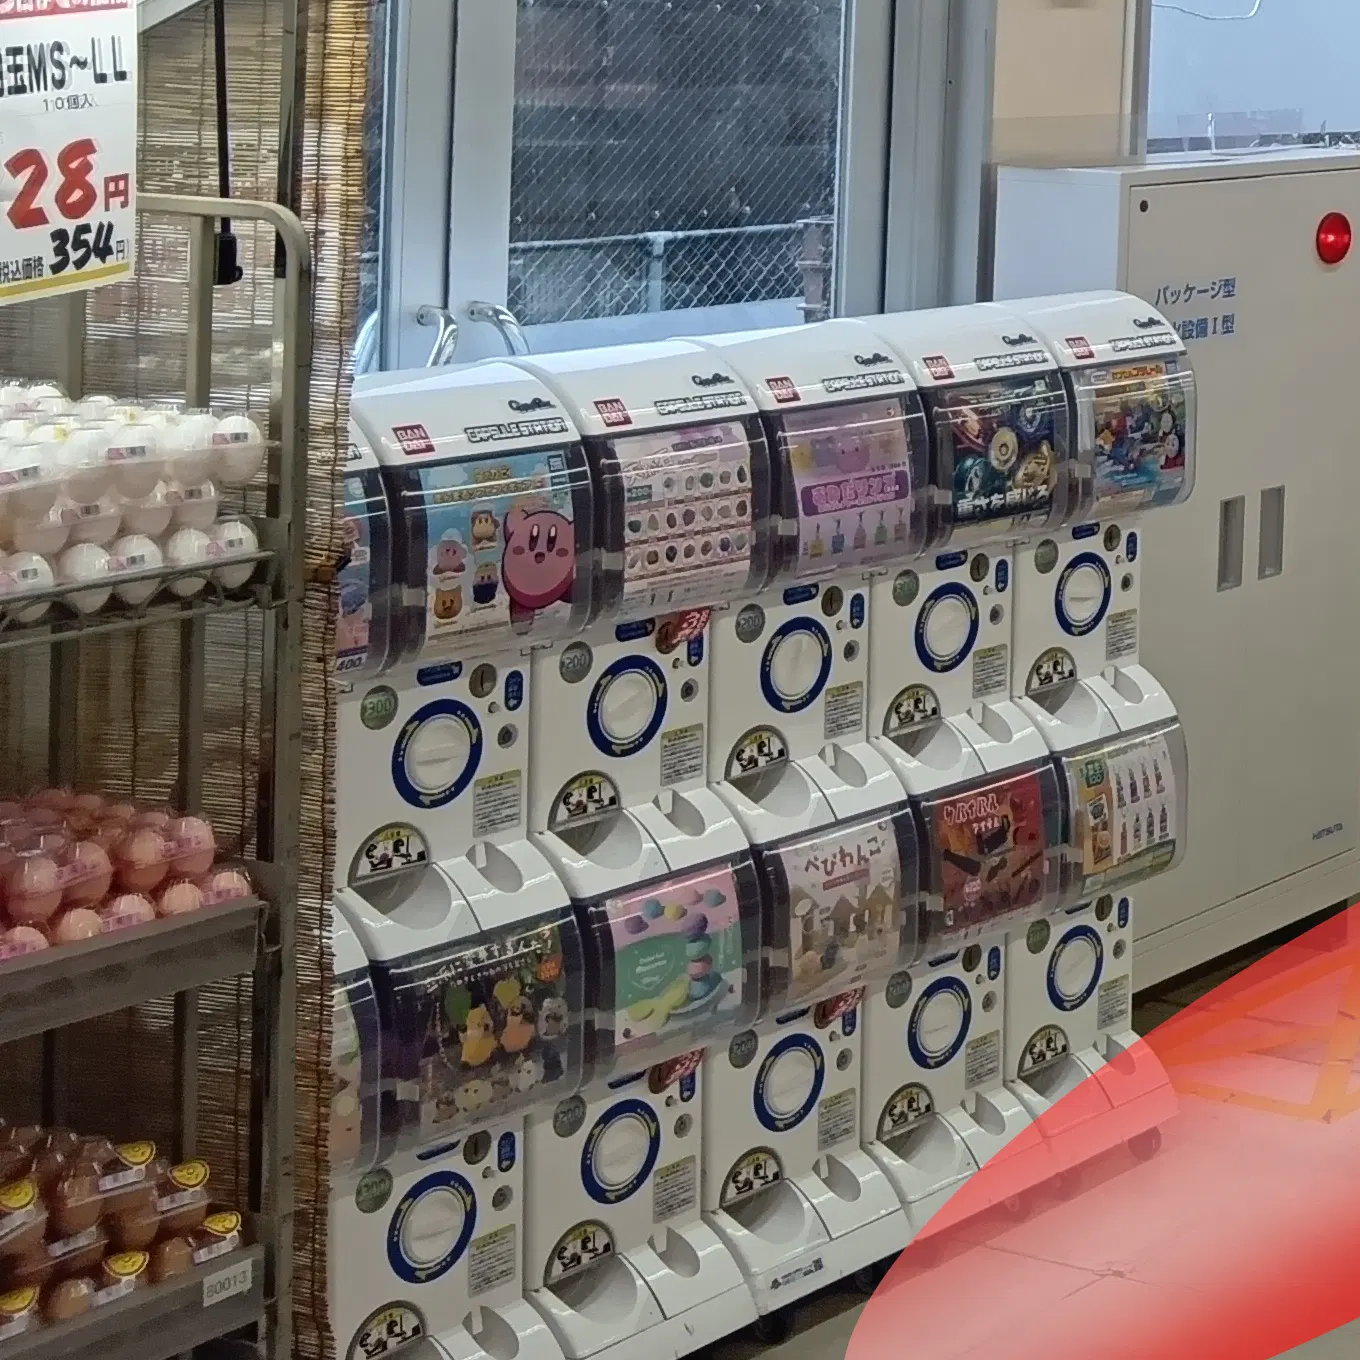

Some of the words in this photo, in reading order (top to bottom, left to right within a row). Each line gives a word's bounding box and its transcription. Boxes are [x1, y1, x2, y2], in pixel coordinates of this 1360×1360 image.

[0, 35, 127, 95] 玉MS~LL
[103, 173, 130, 213] 円
[49, 220, 114, 275] 354
[1155, 277, 1236, 306] パッケージ型
